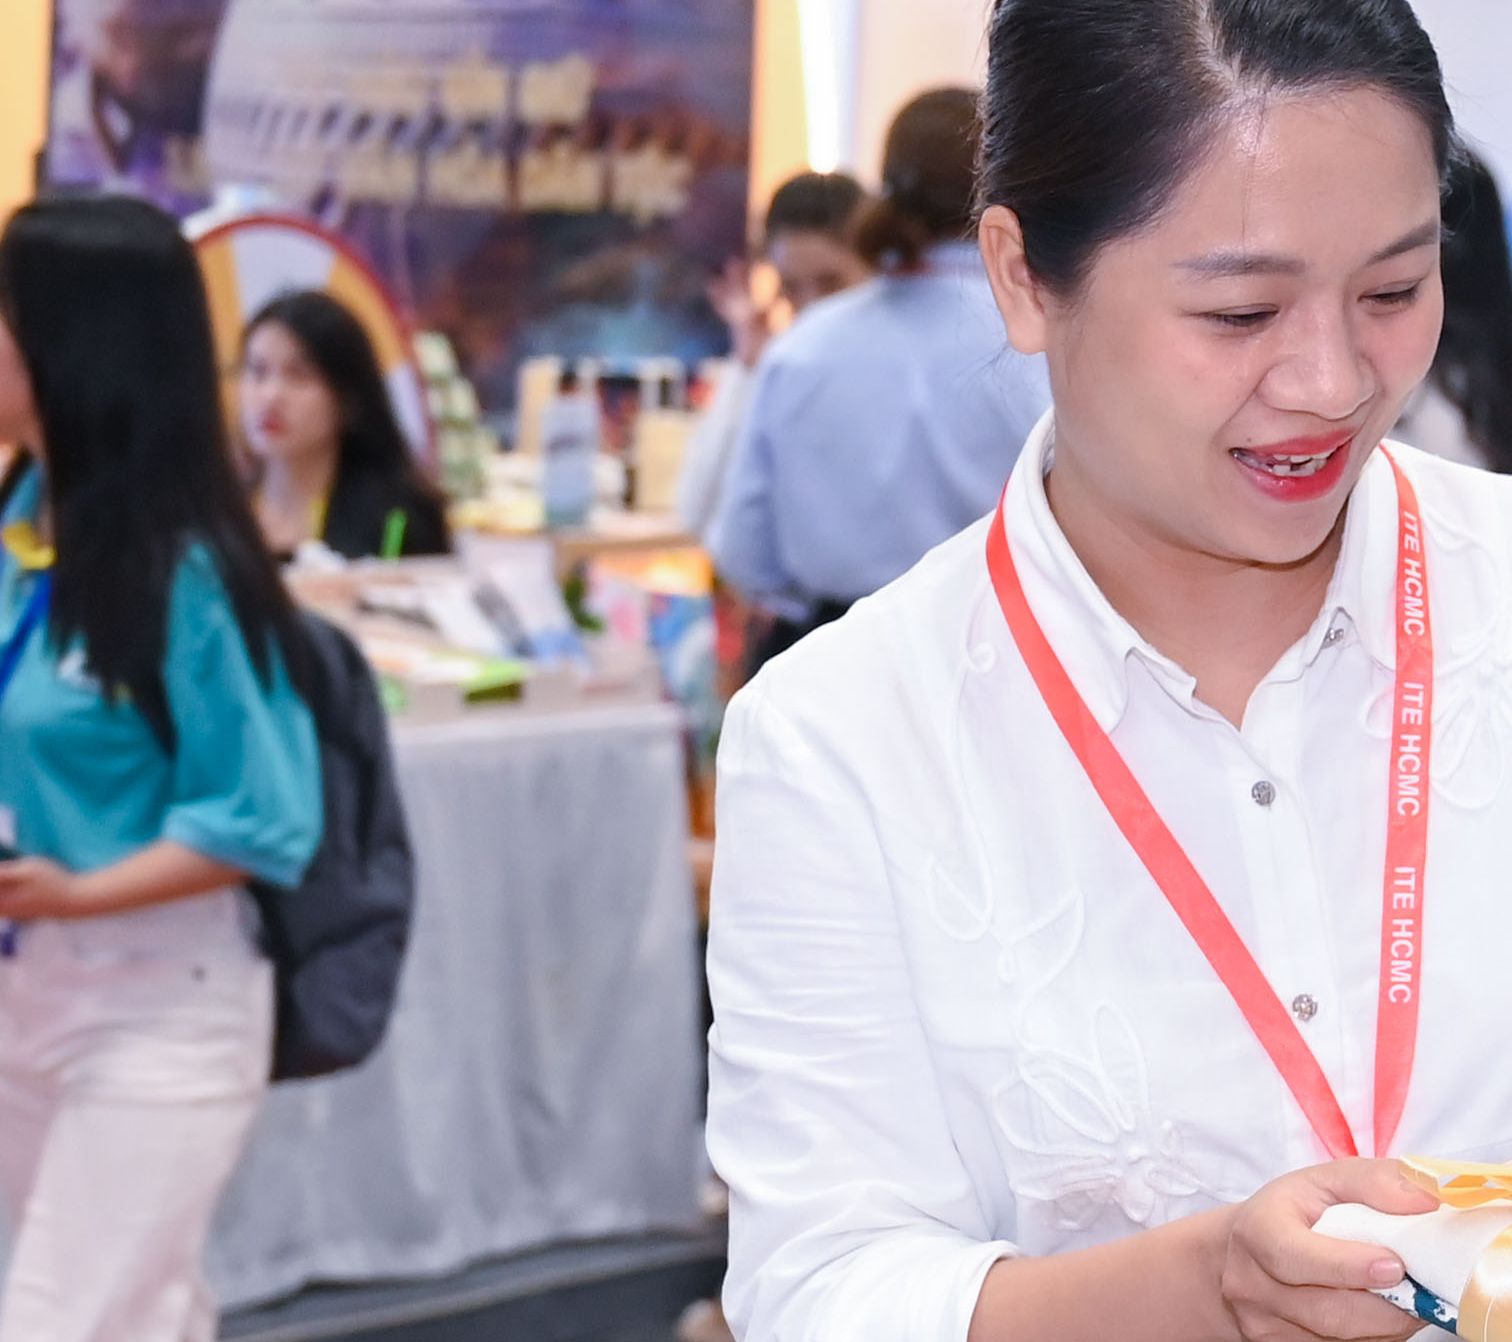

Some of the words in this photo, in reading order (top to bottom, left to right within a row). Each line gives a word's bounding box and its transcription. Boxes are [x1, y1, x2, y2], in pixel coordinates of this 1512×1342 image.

[1402, 511, 1421, 553] ITE
[1402, 556, 1427, 638] HCMC
[1399, 681, 1424, 730] ITE
[1395, 733, 1423, 817] HCMC
[1392, 866, 1419, 911] ITE
[1388, 916, 1416, 1005] HCMC
